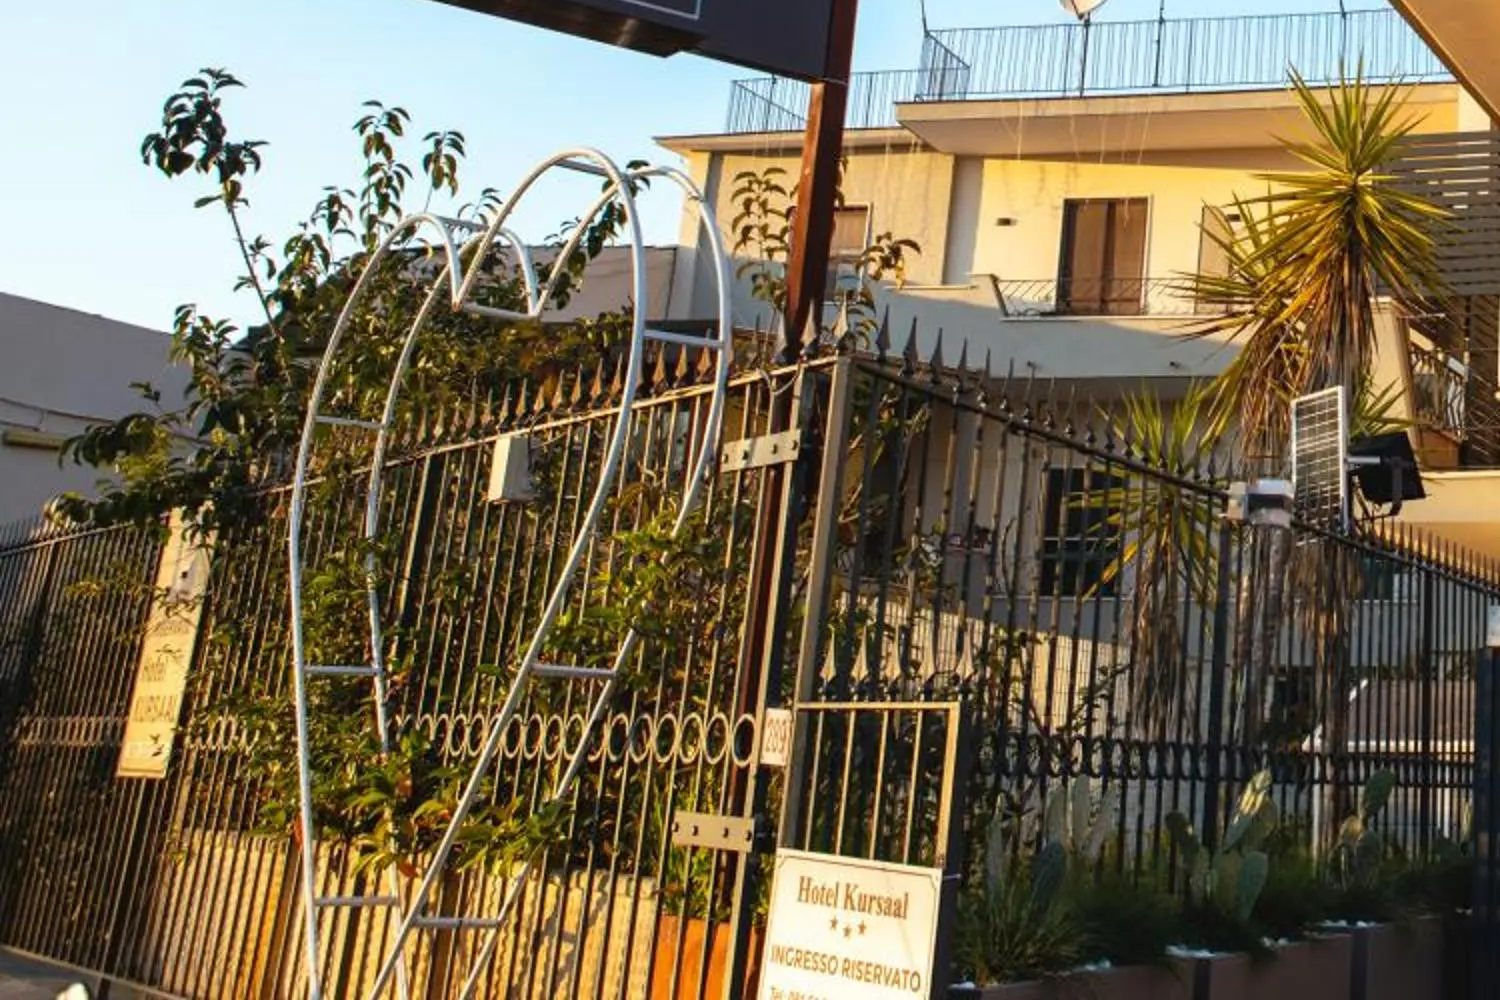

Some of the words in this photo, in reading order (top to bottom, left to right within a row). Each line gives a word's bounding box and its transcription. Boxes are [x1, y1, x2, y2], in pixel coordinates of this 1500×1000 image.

[797, 874, 840, 910] Hotel
[843, 882, 910, 921] Kursaal
[770, 944, 839, 976] INGRESSO
[841, 958, 922, 994] RISERVATO
